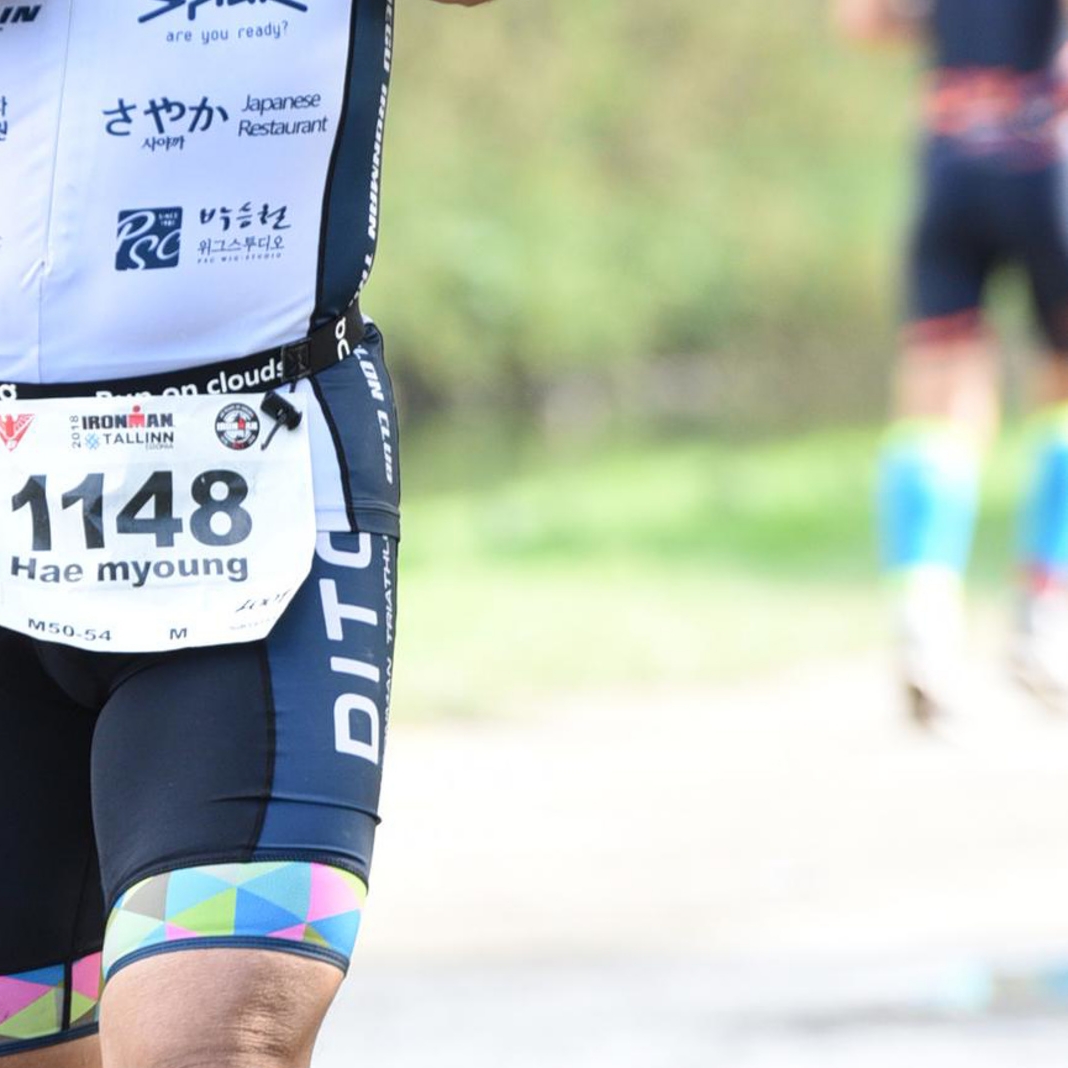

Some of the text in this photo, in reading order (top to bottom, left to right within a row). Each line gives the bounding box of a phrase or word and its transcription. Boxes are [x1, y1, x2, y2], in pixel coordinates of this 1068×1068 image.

[166, 20, 289, 45] are you ready?
[102, 96, 230, 136] さやか
[241, 93, 322, 116] Japanese
[237, 116, 329, 138] Restaurant
[206, 358, 284, 395] clouds
[82, 406, 174, 431] IRONMAN
[103, 431, 174, 444] TALLINN
[11, 469, 253, 552] 1148
[10, 556, 248, 587] Hae myoung
[27, 618, 188, 642] M50-54 M
